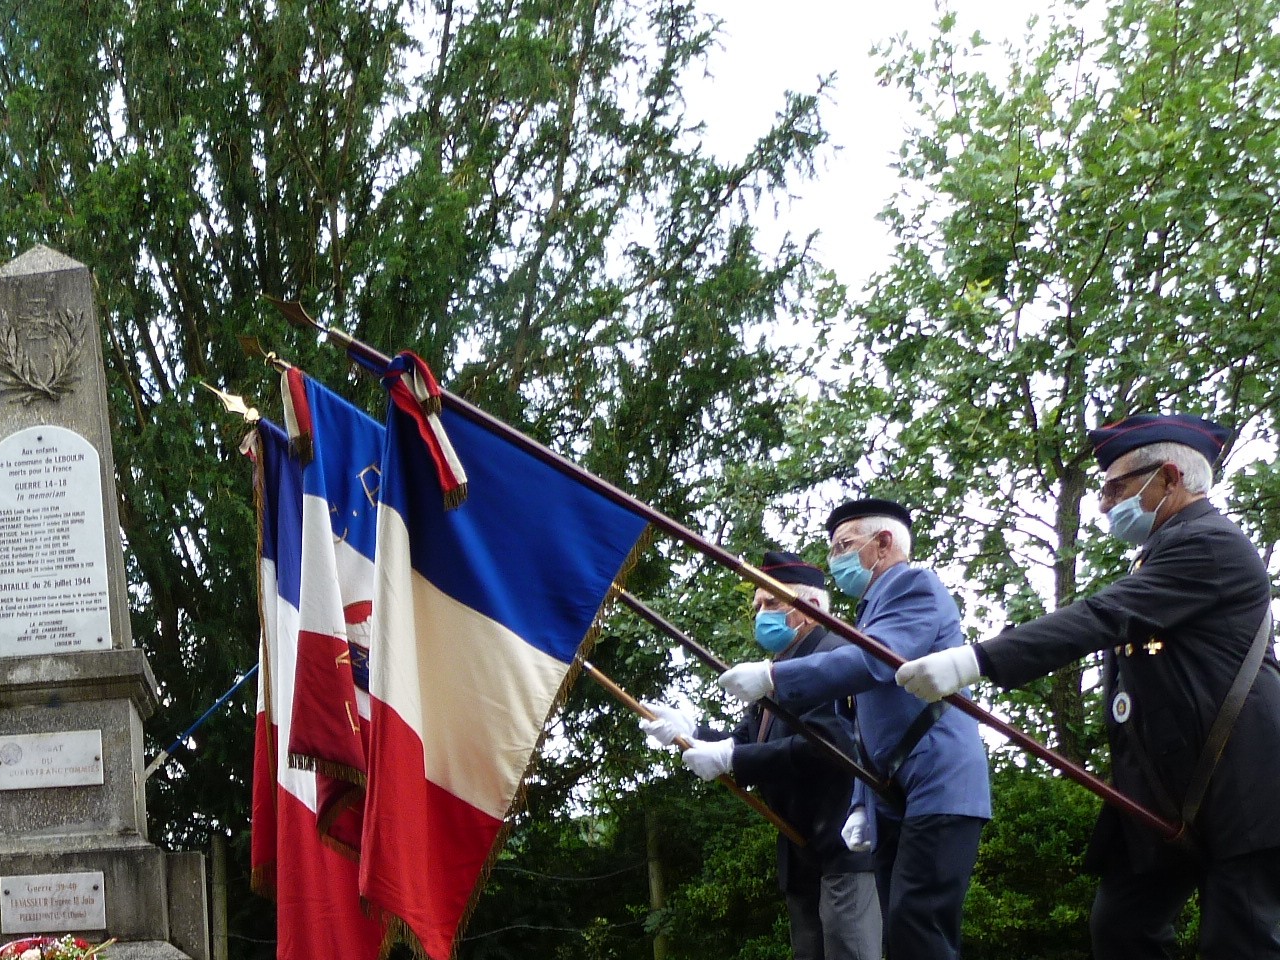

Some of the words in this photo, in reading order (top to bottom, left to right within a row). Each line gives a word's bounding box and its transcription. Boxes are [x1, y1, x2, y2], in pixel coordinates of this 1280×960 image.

[22, 448, 33, 456] Aux
[35, 447, 58, 455] enfants
[14, 458, 43, 467] commune
[45, 457, 53, 465] de
[54, 454, 85, 463] LEBOULIN
[8, 469, 27, 477] morts
[29, 468, 42, 477] pour
[52, 465, 72, 473] France
[14, 480, 42, 491] GUERRE
[16, 493, 25, 501] In
[28, 491, 66, 500] memoriam
[32, 580, 41, 589] du
[43, 579, 52, 588] 26
[54, 578, 71, 589] juillet
[75, 577, 91, 586] 1944
